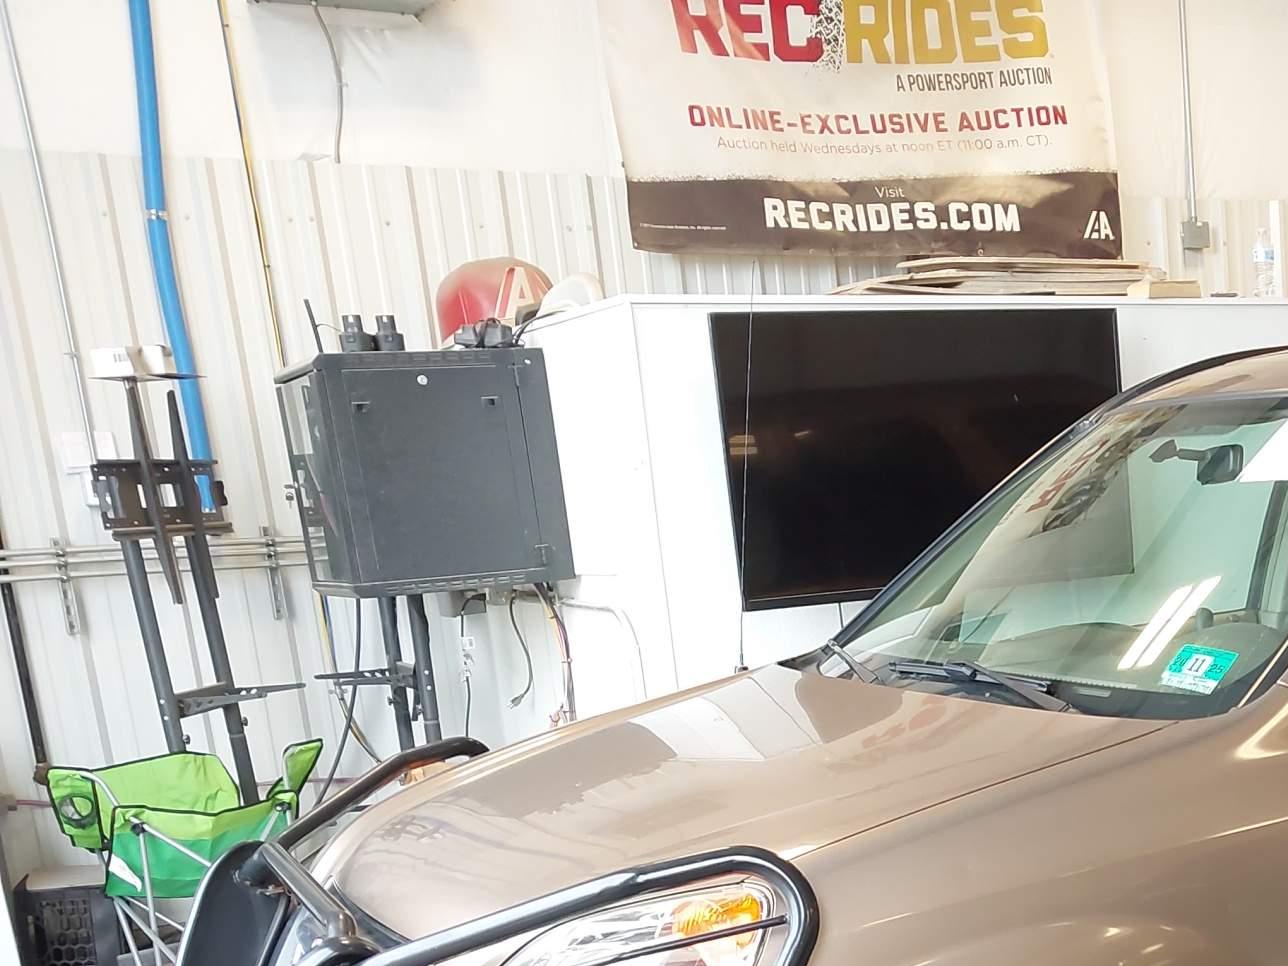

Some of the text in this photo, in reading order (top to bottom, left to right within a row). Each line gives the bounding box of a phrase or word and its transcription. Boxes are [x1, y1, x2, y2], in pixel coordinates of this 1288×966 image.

[671, 0, 1049, 64] REC RIDES
[896, 67, 1053, 92] A POWERSPORT AUCTION
[688, 104, 1068, 134] ONLINE-EXCLUSIVE AUCTION
[717, 136, 767, 150] Auction
[770, 139, 797, 153] held
[800, 142, 881, 155] Wednesdays
[885, 143, 898, 152] at
[902, 142, 934, 152] noon
[937, 140, 953, 150] ET
[957, 138, 993, 151] (11:00
[996, 138, 1023, 150] a.m.
[874, 185, 905, 198] Visit
[763, 197, 1021, 232] RECRIDES.COM
